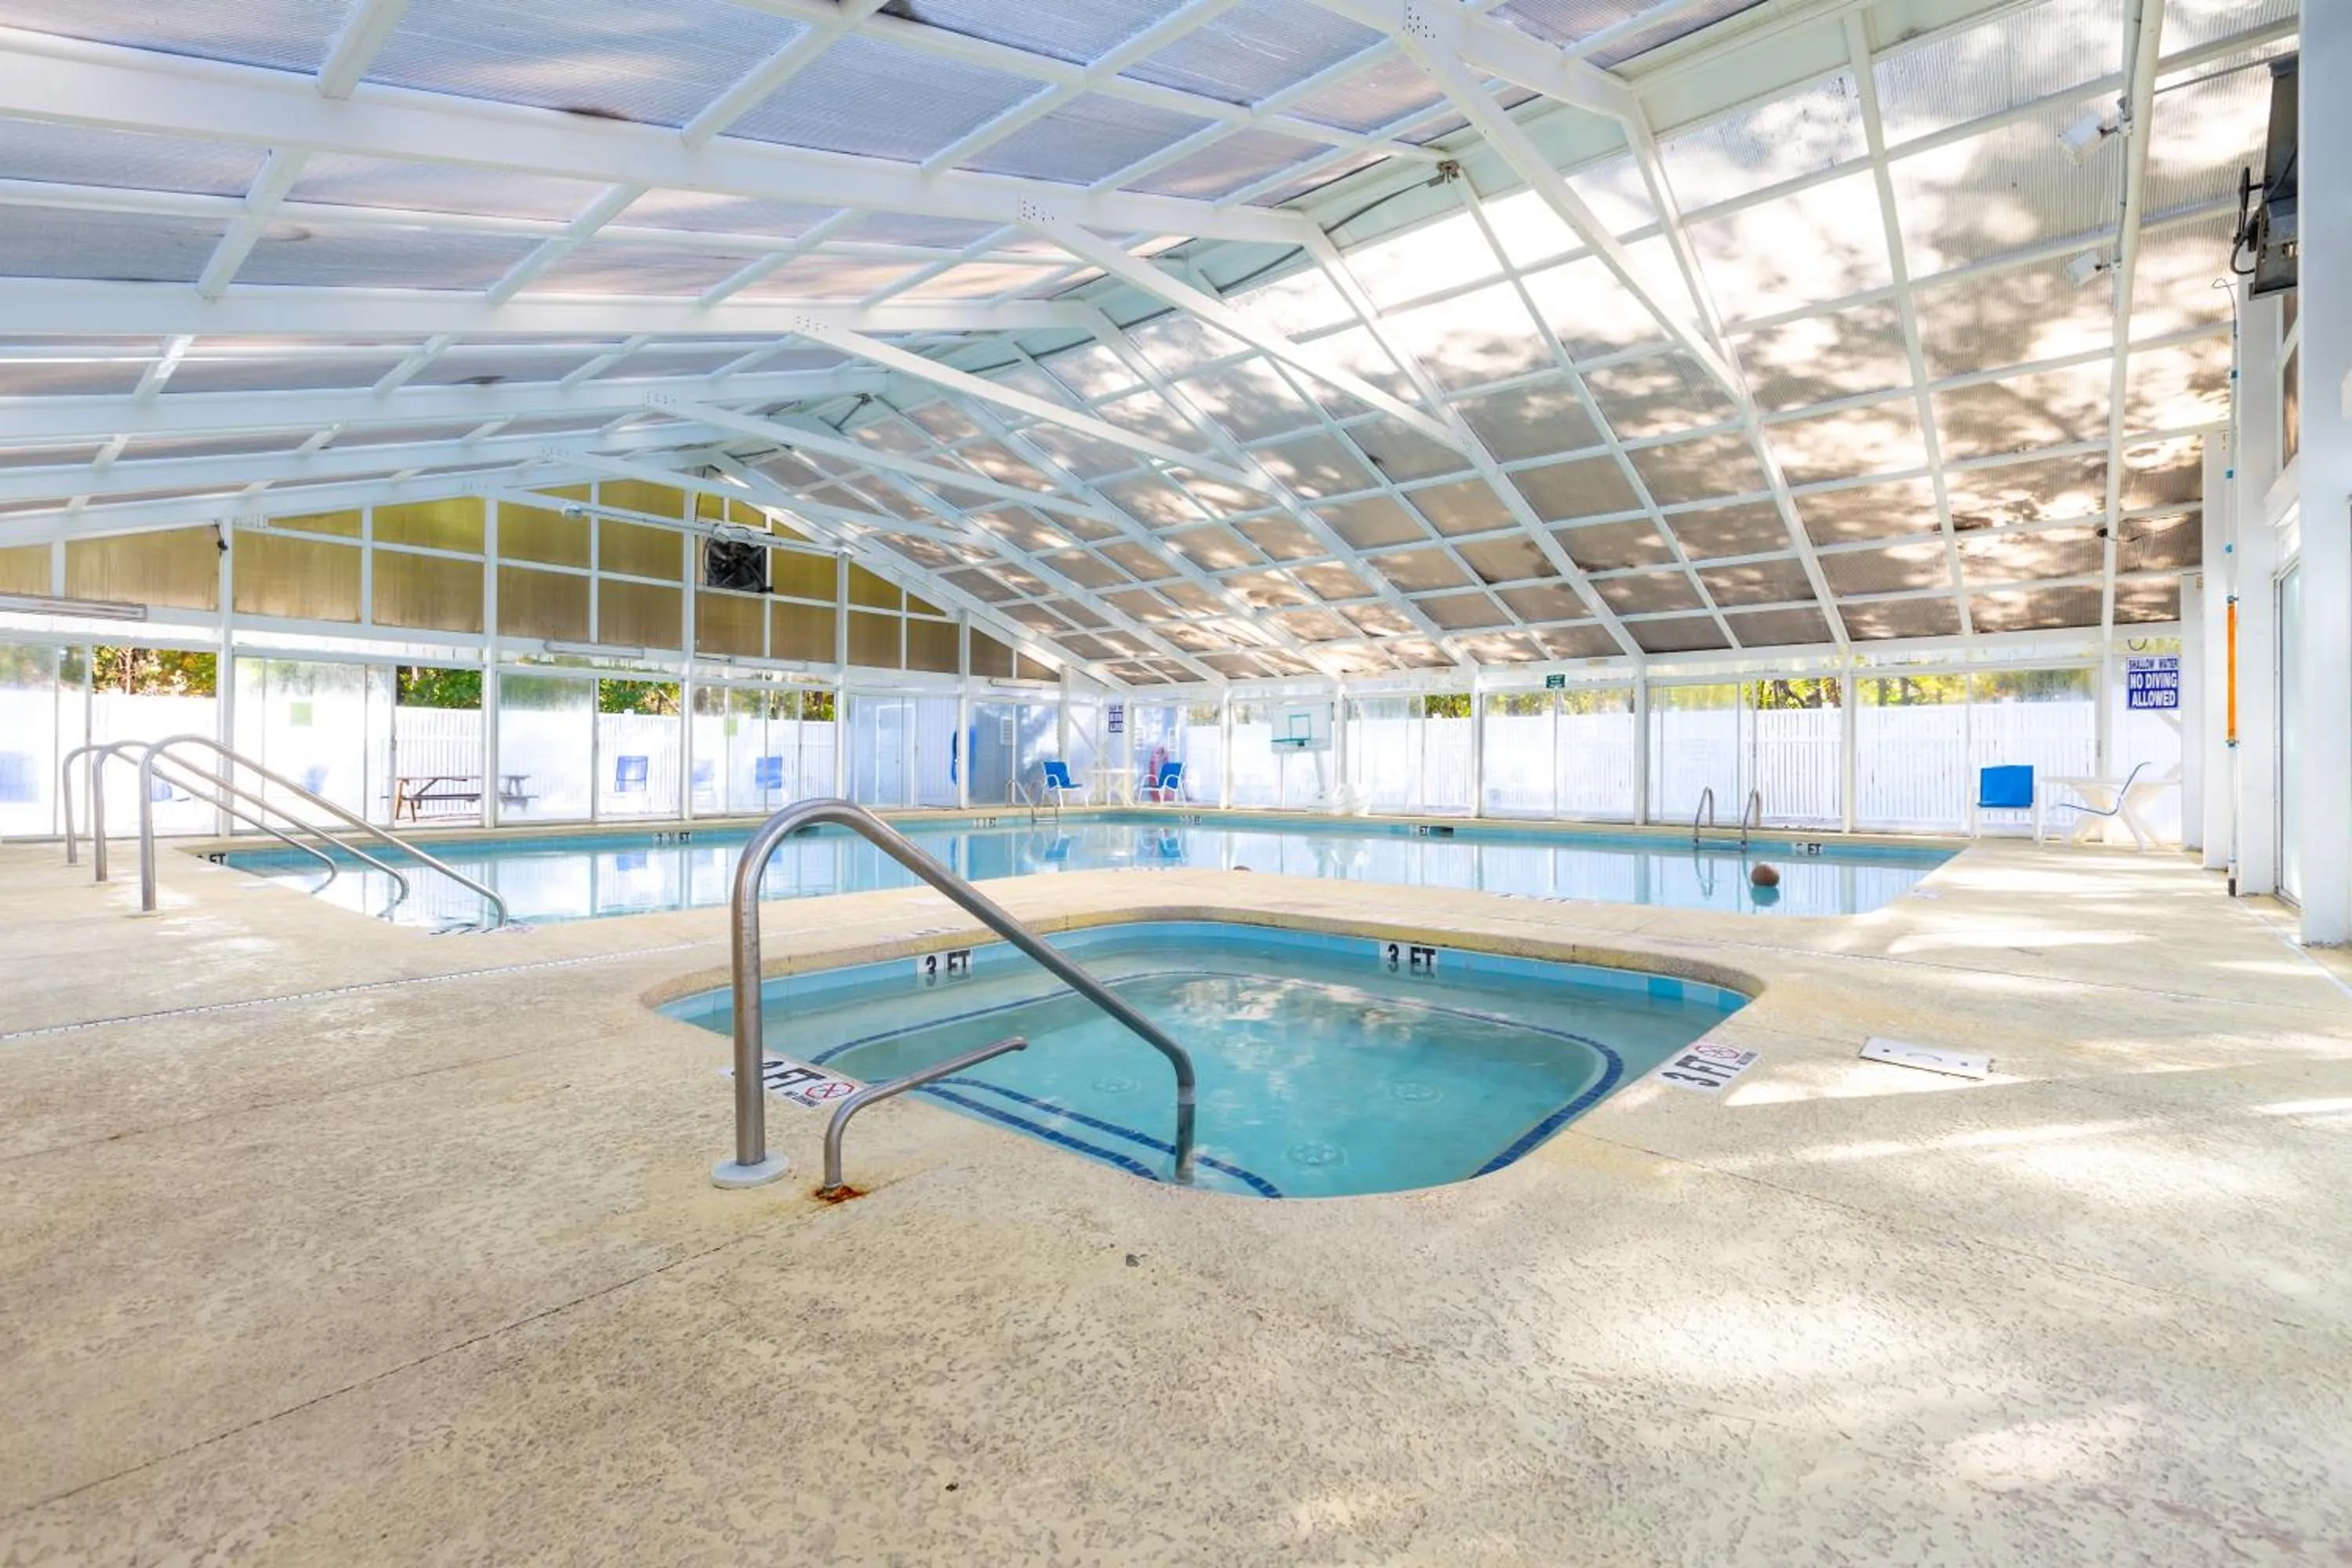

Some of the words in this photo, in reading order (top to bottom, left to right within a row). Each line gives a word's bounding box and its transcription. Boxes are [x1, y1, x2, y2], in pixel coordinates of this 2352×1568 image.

[2130, 673, 2143, 689] NO
[2145, 672, 2177, 688] DIVING
[2132, 690, 2176, 707] ALLOWED
[946, 949, 971, 971] FT
[1410, 946, 1436, 966] FT
[1675, 1054, 1740, 1078] FT
[1662, 1072, 1720, 1087] 3
